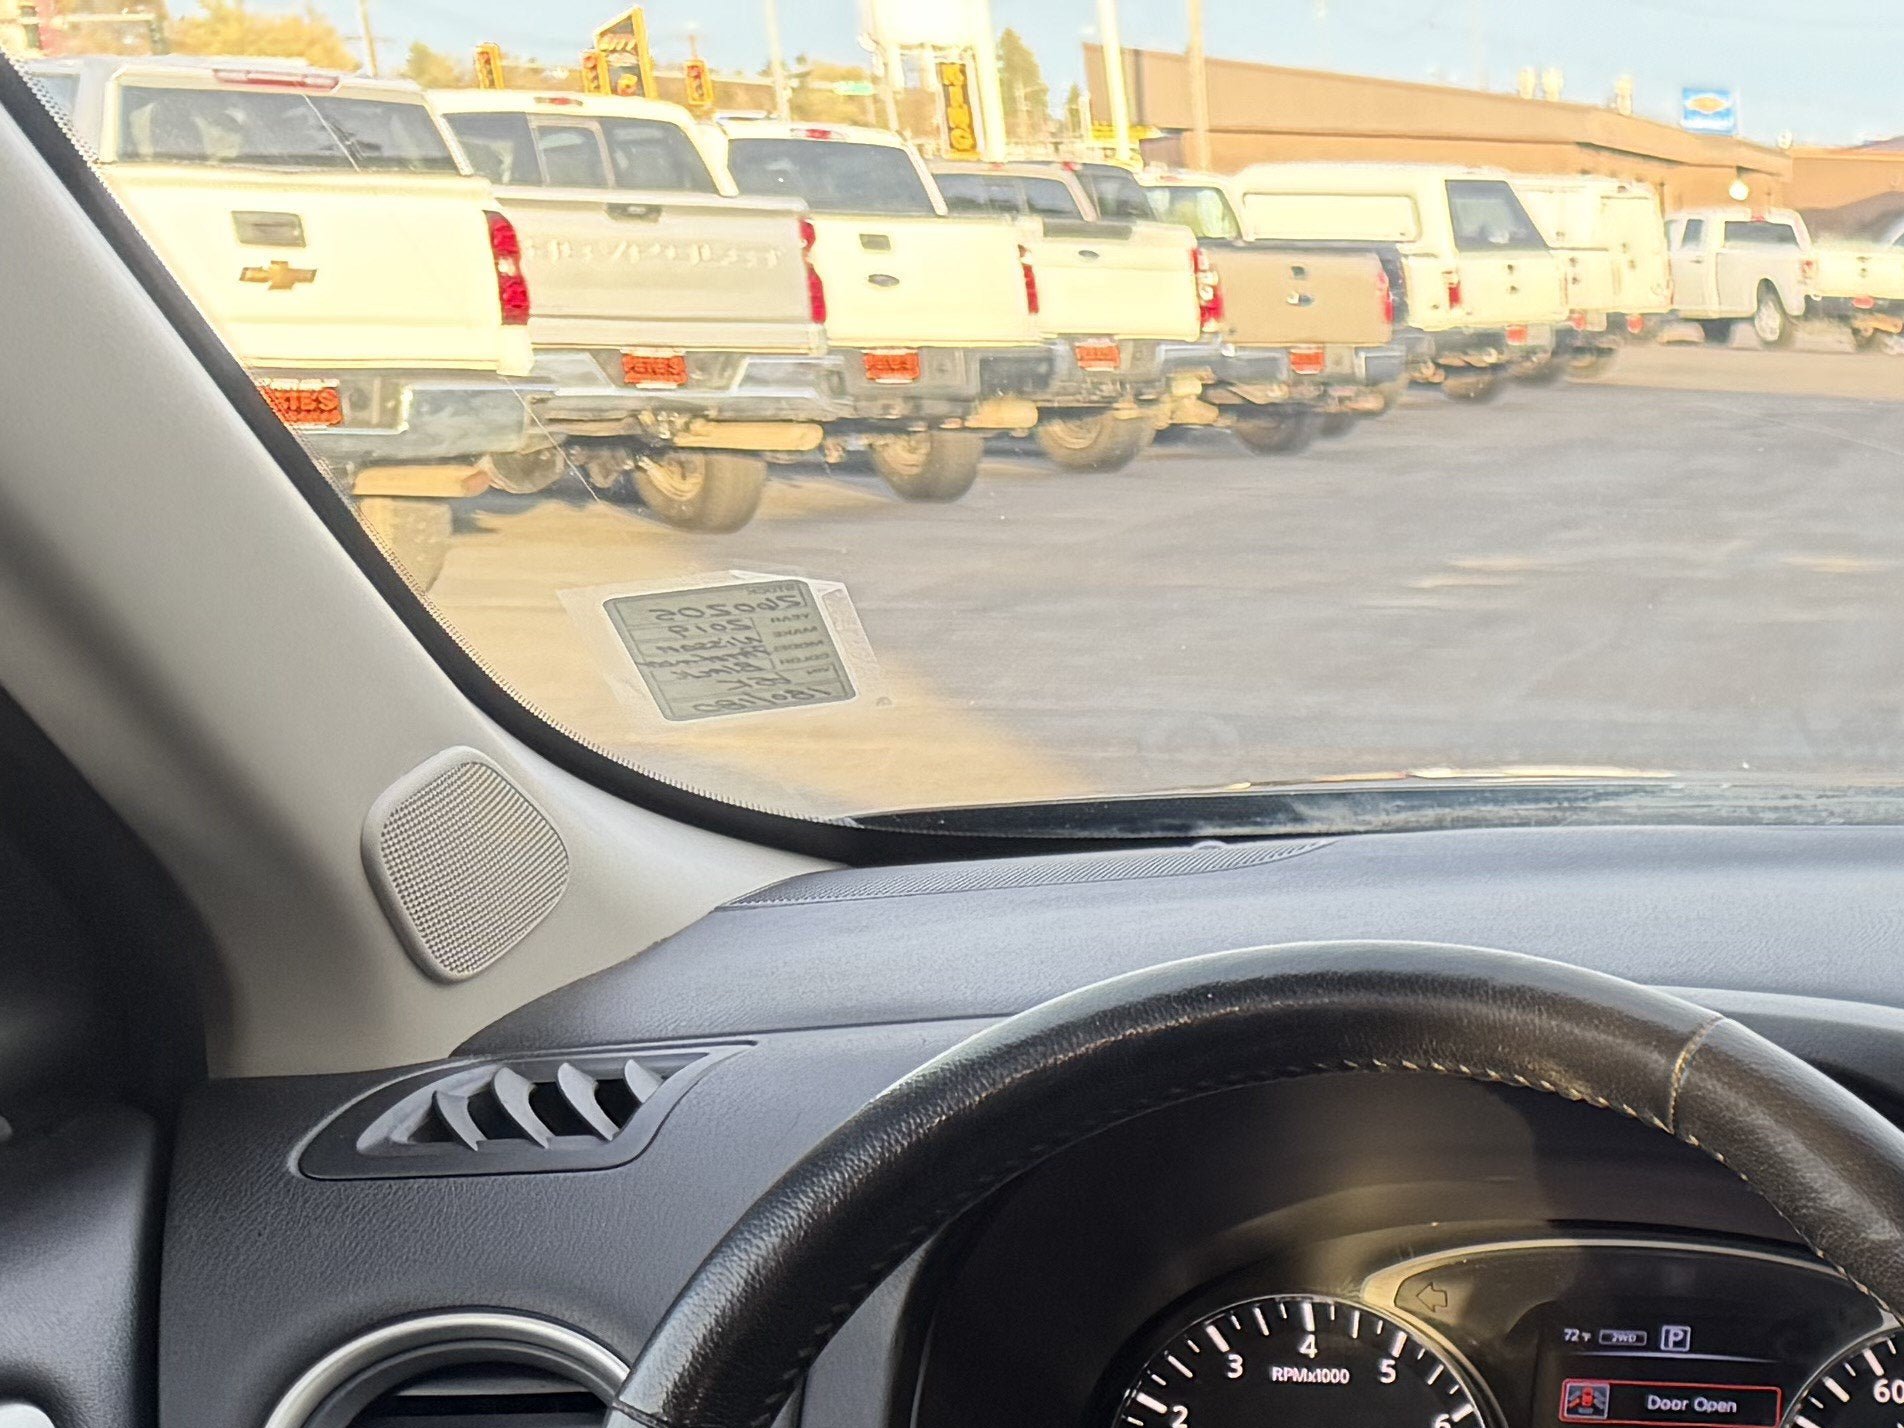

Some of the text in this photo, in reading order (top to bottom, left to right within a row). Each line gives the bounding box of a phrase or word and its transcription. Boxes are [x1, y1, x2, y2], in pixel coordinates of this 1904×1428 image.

[1300, 1335, 1317, 1358] 4
[1668, 1328, 1684, 1348] P
[1227, 1354, 1243, 1378] 3
[1272, 1366, 1350, 1384] RPMx1000
[1380, 1358, 1396, 1383] 5
[1647, 1394, 1737, 1414] Door Open
[1172, 1406, 1188, 1428] 2
